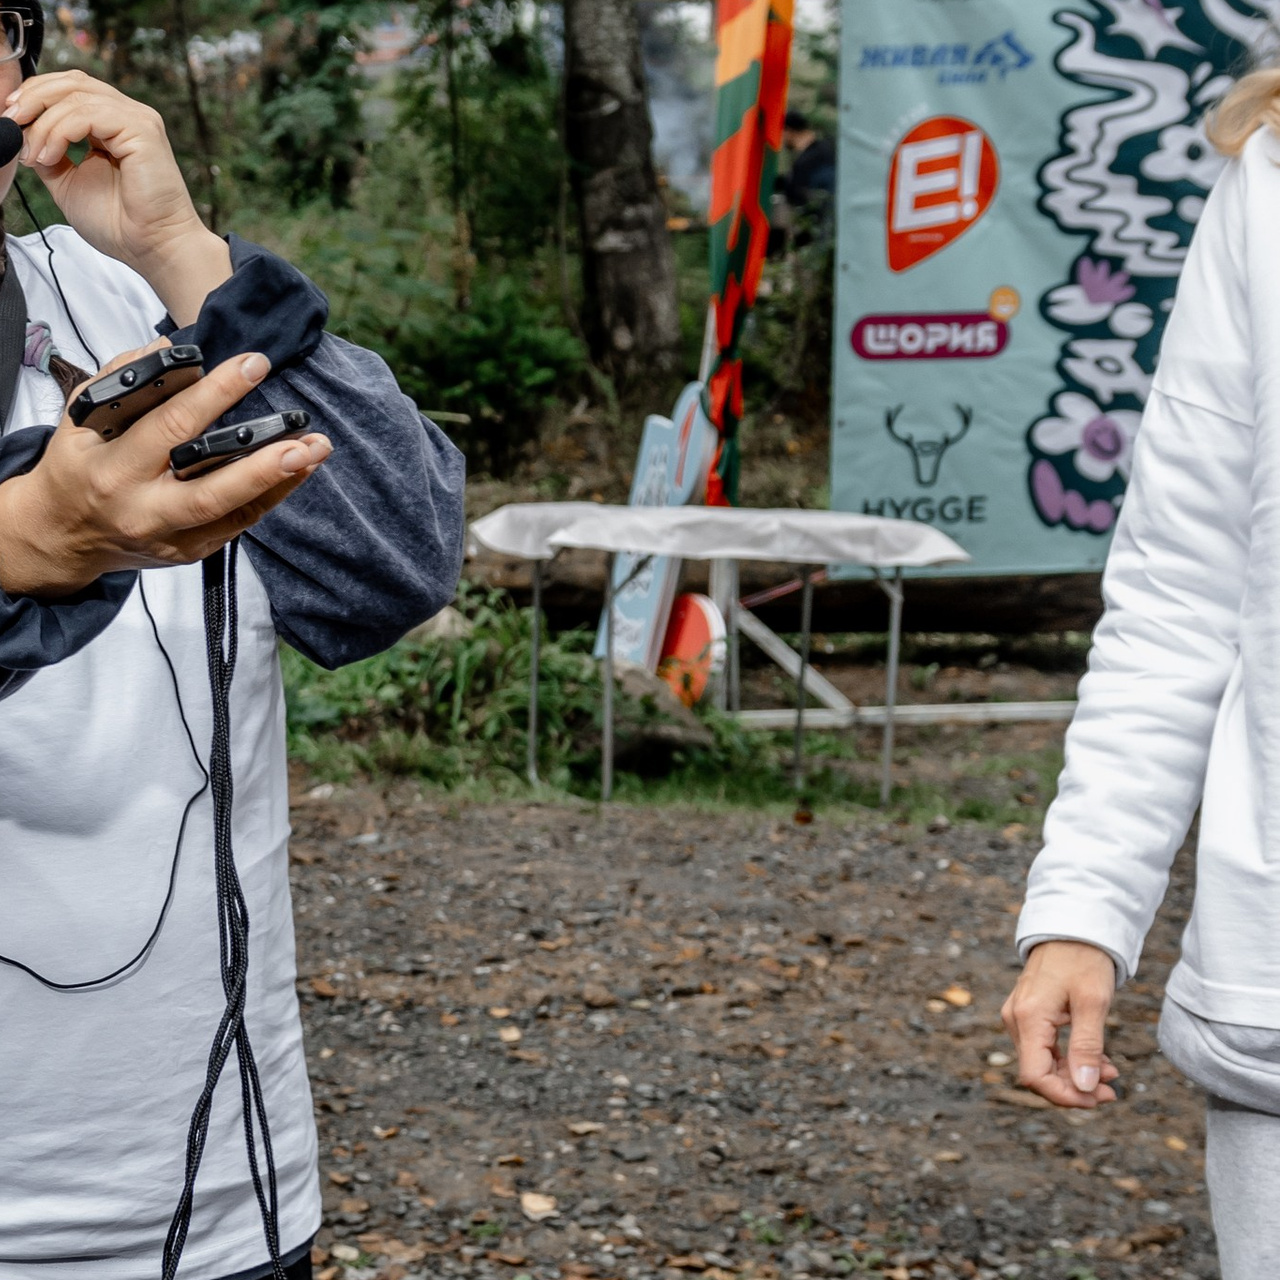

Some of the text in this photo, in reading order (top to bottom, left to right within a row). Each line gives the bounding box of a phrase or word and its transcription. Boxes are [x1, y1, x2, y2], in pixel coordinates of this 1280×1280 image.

[892, 130, 983, 233] E!
[863, 322, 998, 355] ШОРИЯ
[862, 496, 987, 523] HYGGE
